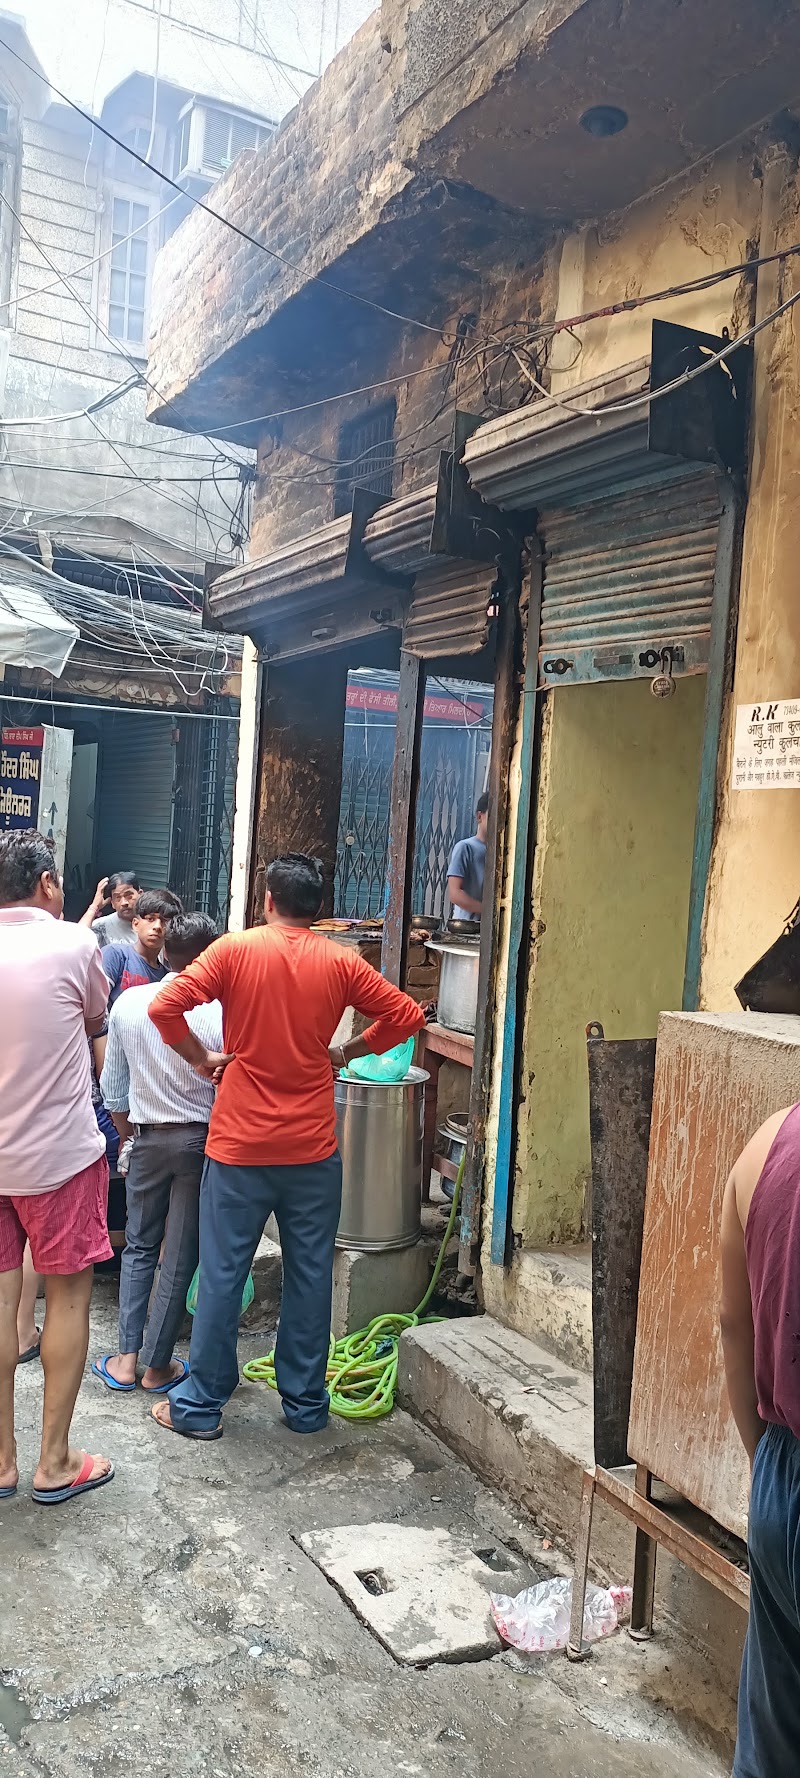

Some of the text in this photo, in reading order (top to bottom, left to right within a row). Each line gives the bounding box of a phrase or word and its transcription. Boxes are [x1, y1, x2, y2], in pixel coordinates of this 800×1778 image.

[359, 690, 368, 703] ਦੀ
[428, 700, 447, 713] ਤਿਆਰ
[751, 704, 779, 722] R.K
[767, 721, 784, 734] वाला
[19, 751, 39, 781] ਸਿੰਘ
